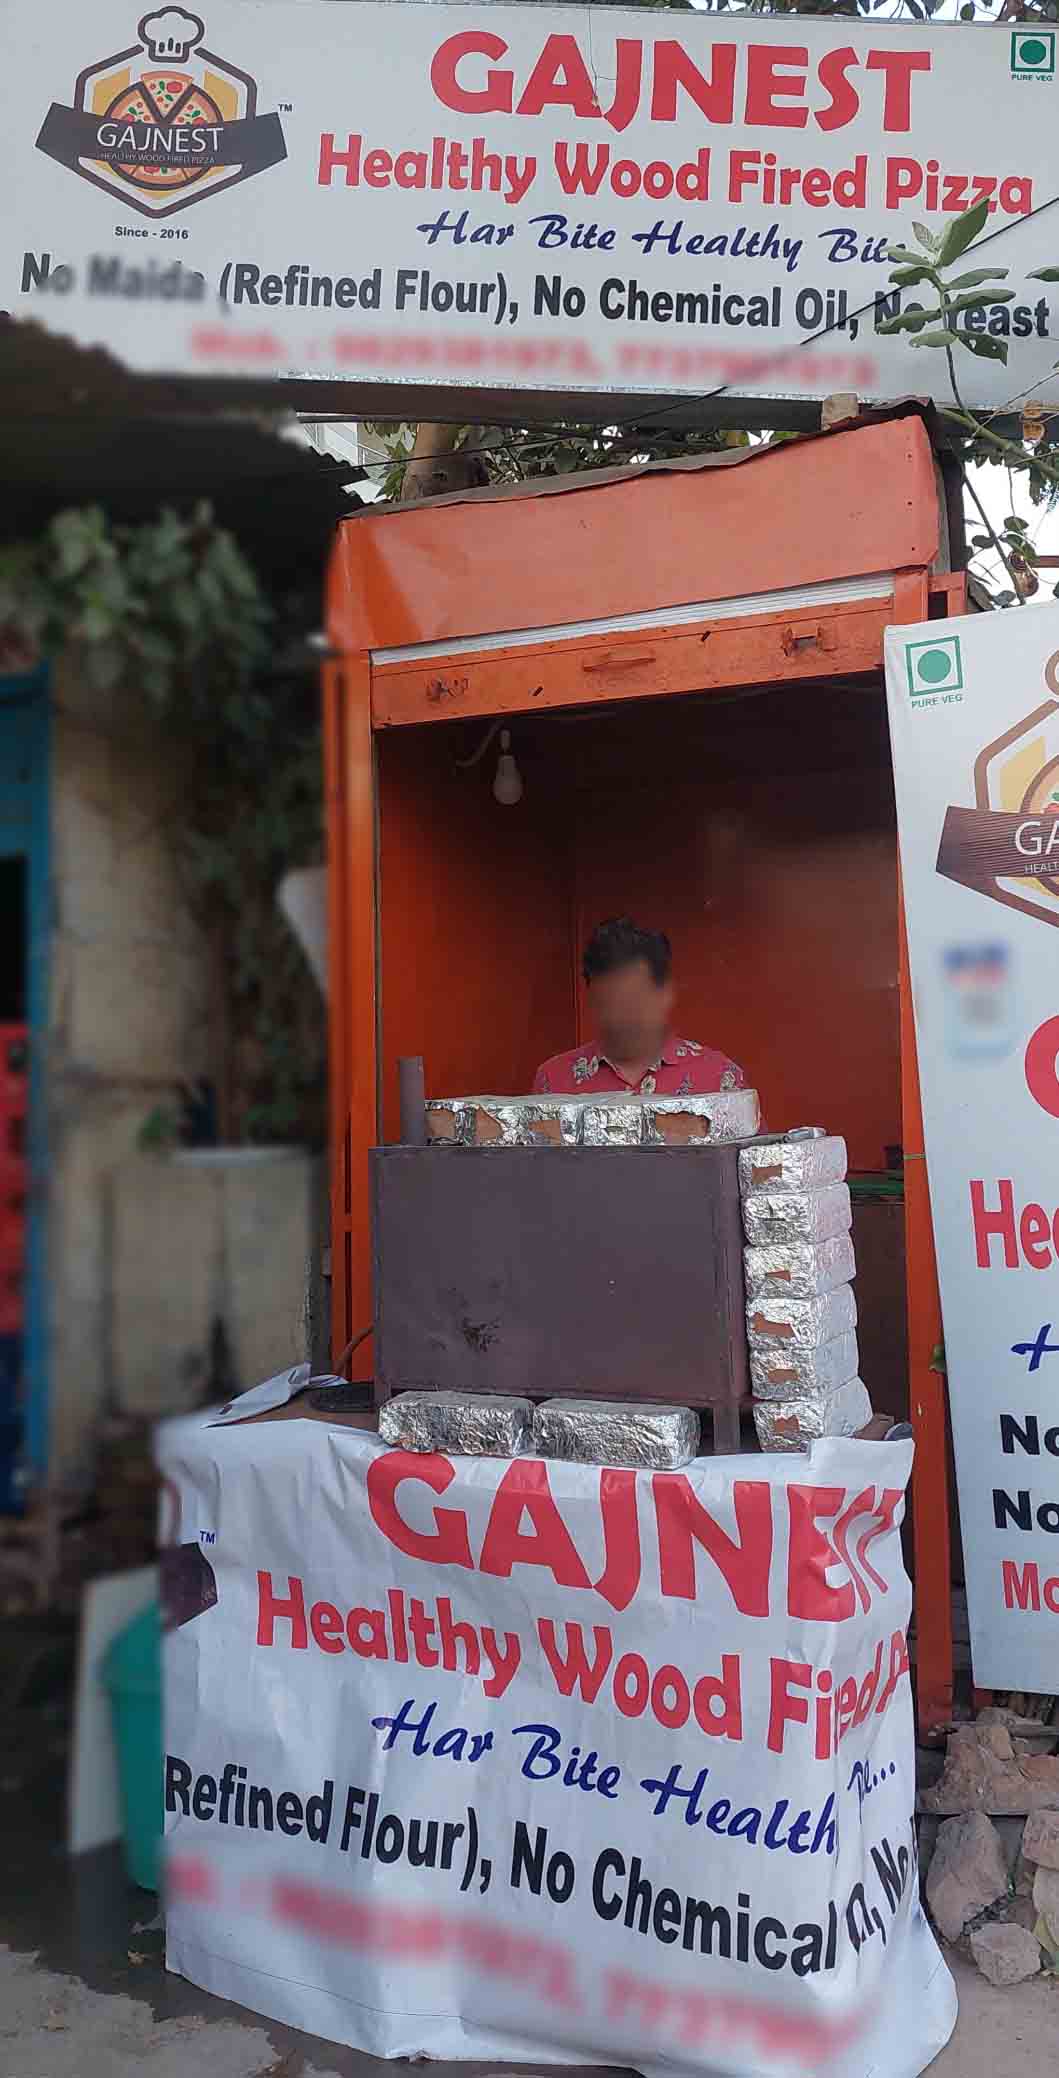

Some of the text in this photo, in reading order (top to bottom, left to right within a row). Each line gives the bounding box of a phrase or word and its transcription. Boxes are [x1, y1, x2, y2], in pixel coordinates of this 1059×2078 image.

[278, 104, 292, 112] TM
[431, 31, 931, 132] GAJNEST
[1036, 74, 1053, 82] VEG
[97, 123, 224, 152] GAJNEST
[318, 133, 1033, 215] Healthy Wood Fired Pizza
[114, 226, 149, 238] Since
[160, 228, 189, 239] 2016
[417, 210, 513, 246] Har
[529, 214, 616, 251] Bite
[632, 223, 802, 272] Healthy
[21, 252, 75, 296] No
[219, 262, 382, 316] (Refined
[396, 270, 519, 324] Flour),
[533, 275, 586, 318] No
[599, 278, 781, 327] Chemical
[795, 288, 859, 340] Oil,
[912, 693, 963, 709] PURE VEG
[970, 1179, 1059, 1269] He
[200, 1530, 216, 1545] TM
[256, 1570, 521, 1698] Healthy
[538, 1618, 744, 1741] Wood
[371, 1699, 494, 1763] Har
[511, 1723, 621, 1799] Bite
[639, 1764, 839, 1868] Health
[165, 1754, 334, 1845] Refined
[341, 1785, 492, 1895] Flour),
[511, 1820, 575, 1904] No
[592, 1846, 838, 1977] Chemical
